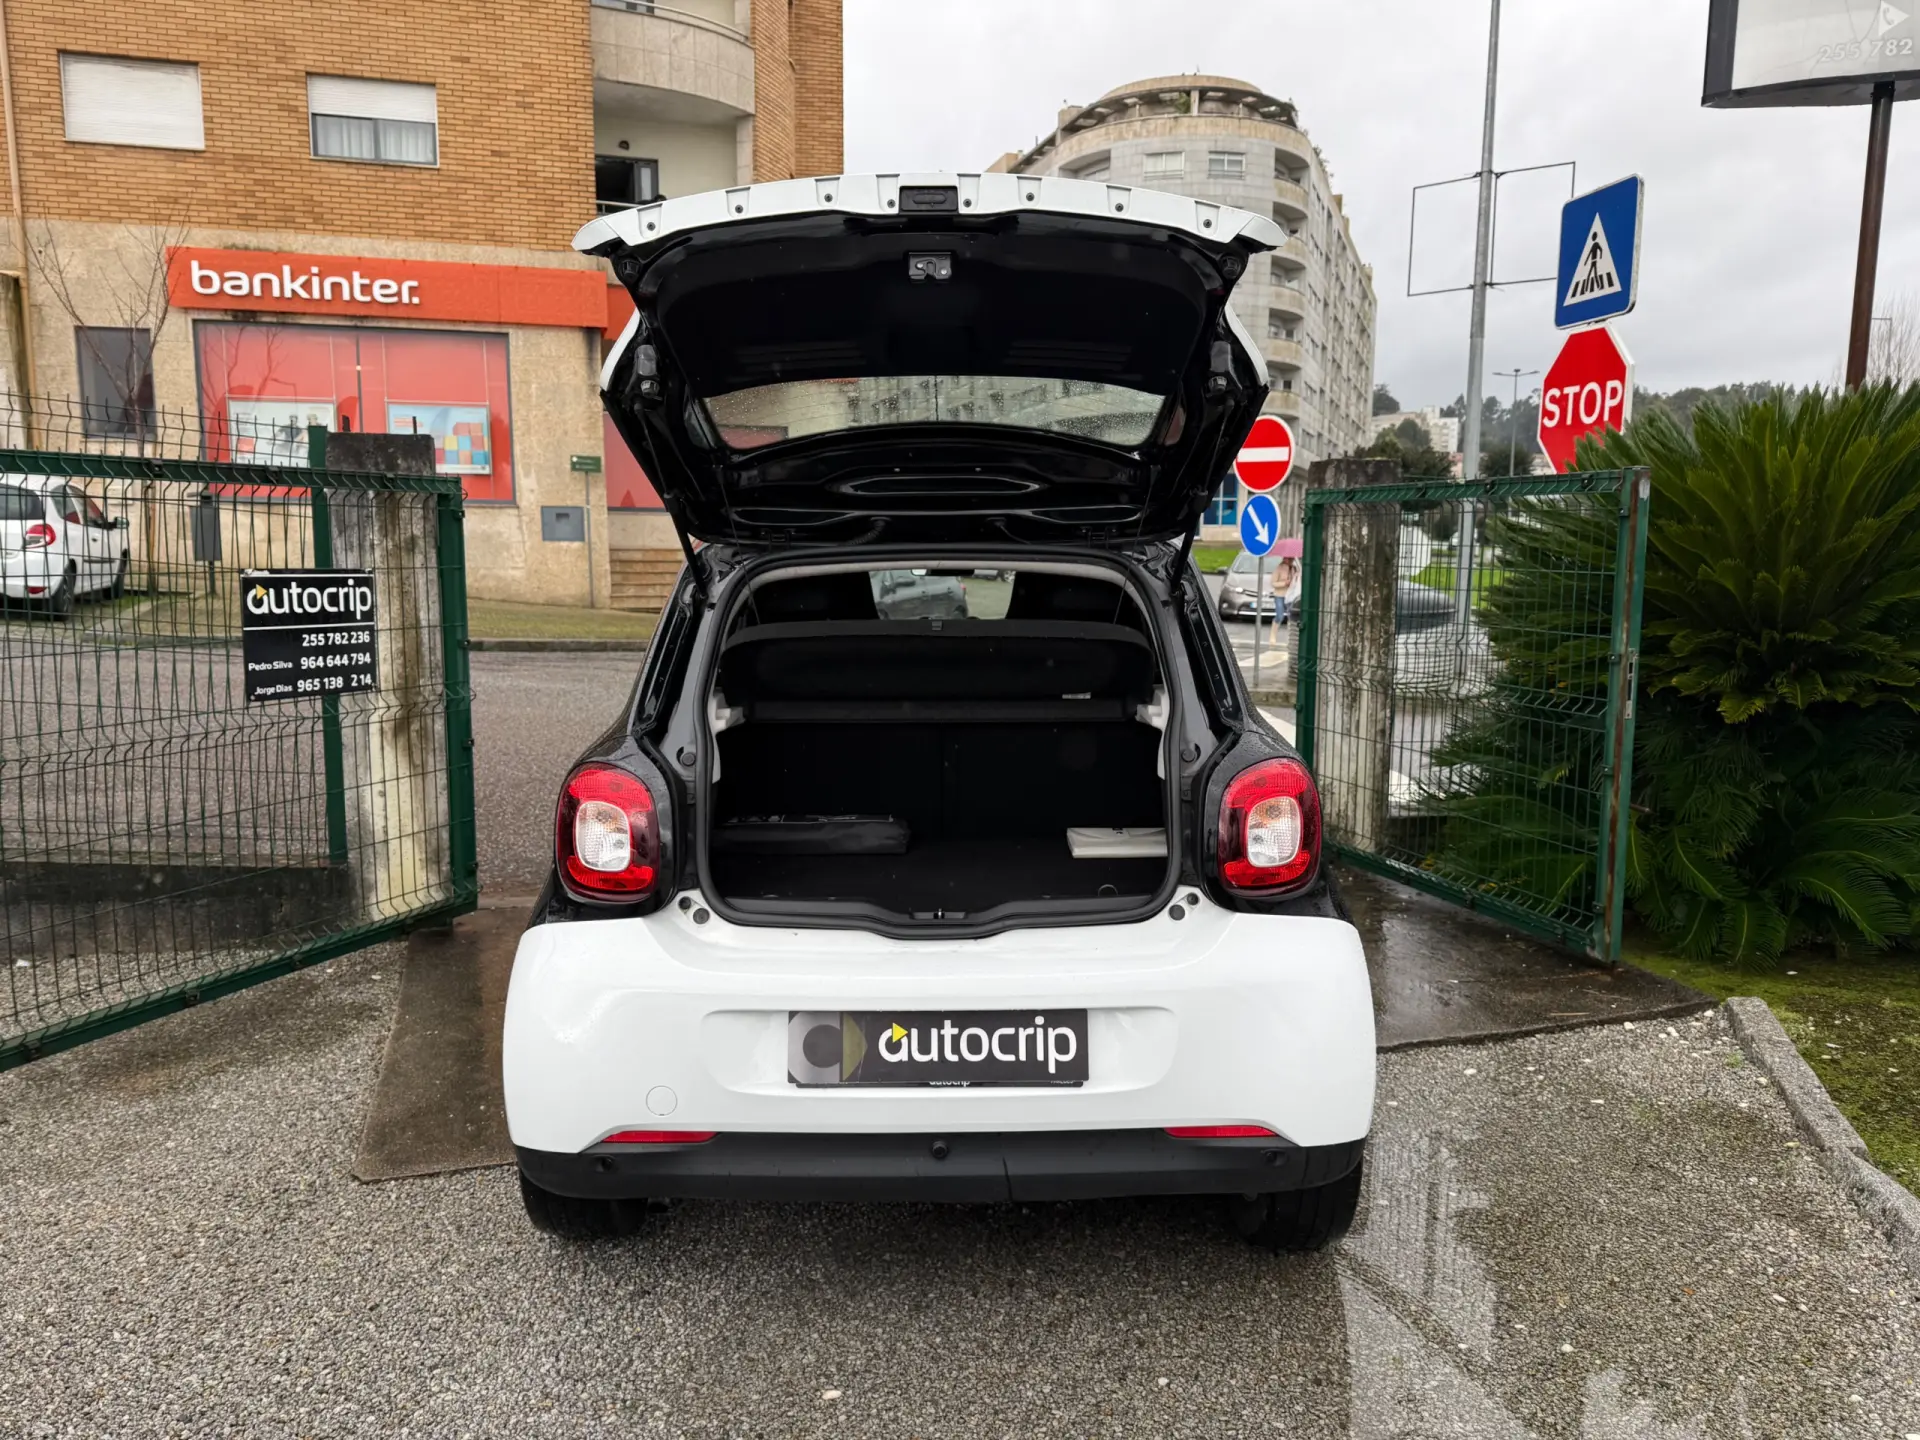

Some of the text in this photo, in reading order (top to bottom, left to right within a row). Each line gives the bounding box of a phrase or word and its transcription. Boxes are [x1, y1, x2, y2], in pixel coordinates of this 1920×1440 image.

[1820, 38, 1913, 61] 255 782
[1542, 379, 1623, 428] STOP
[246, 578, 372, 620] autocrip
[302, 631, 370, 647] 255 782 236
[248, 652, 371, 671] Pedro Silva 964 644 794
[254, 686, 276, 695] Jorge
[276, 684, 293, 693] Dias
[297, 678, 320, 692] 965
[323, 676, 344, 690] 138
[878, 1016, 1077, 1074] autocrip
